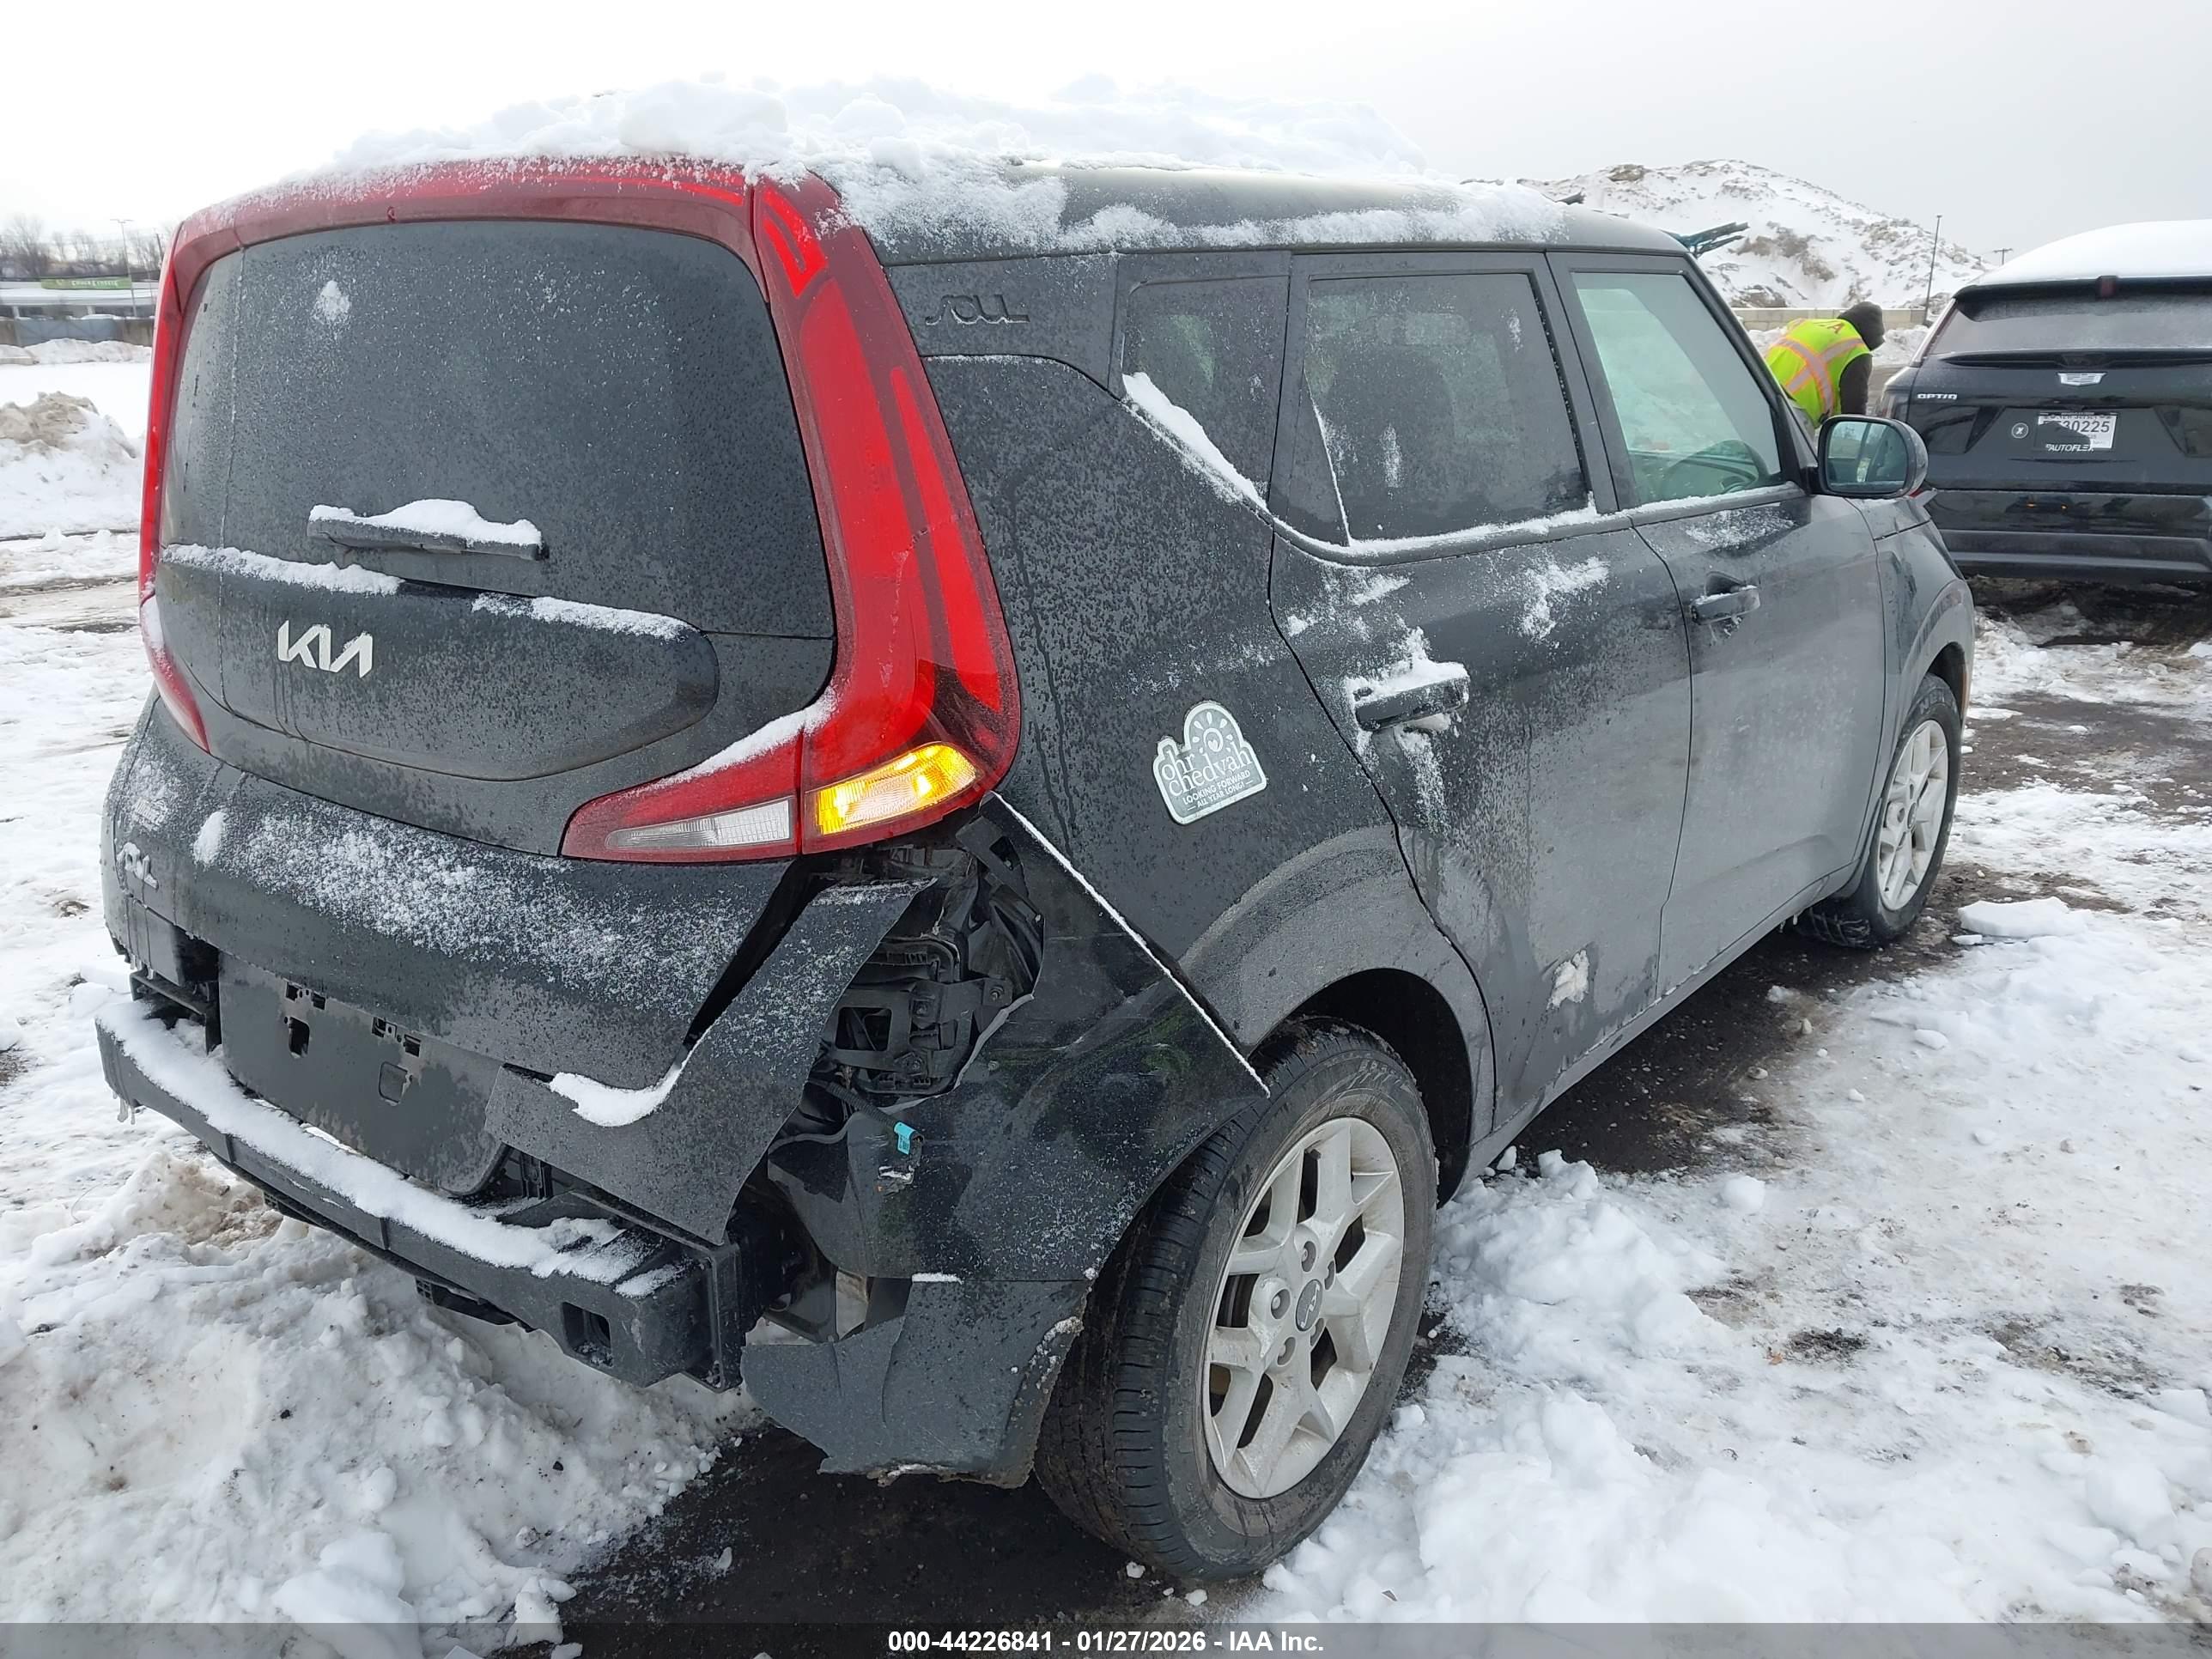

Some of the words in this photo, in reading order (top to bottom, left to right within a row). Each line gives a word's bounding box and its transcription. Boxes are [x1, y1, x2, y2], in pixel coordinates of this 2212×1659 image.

[925, 294, 1030, 325] SOUL
[277, 620, 374, 678] KIA
[1161, 750, 1195, 781] ohr
[1169, 741, 1253, 796] chedvah
[1182, 785, 1217, 805] LOOKING
[1217, 770, 1250, 789] FORWARD
[1197, 797, 1209, 808] ALL
[1209, 790, 1224, 803] YEAR
[1224, 781, 1245, 795] LONG!
